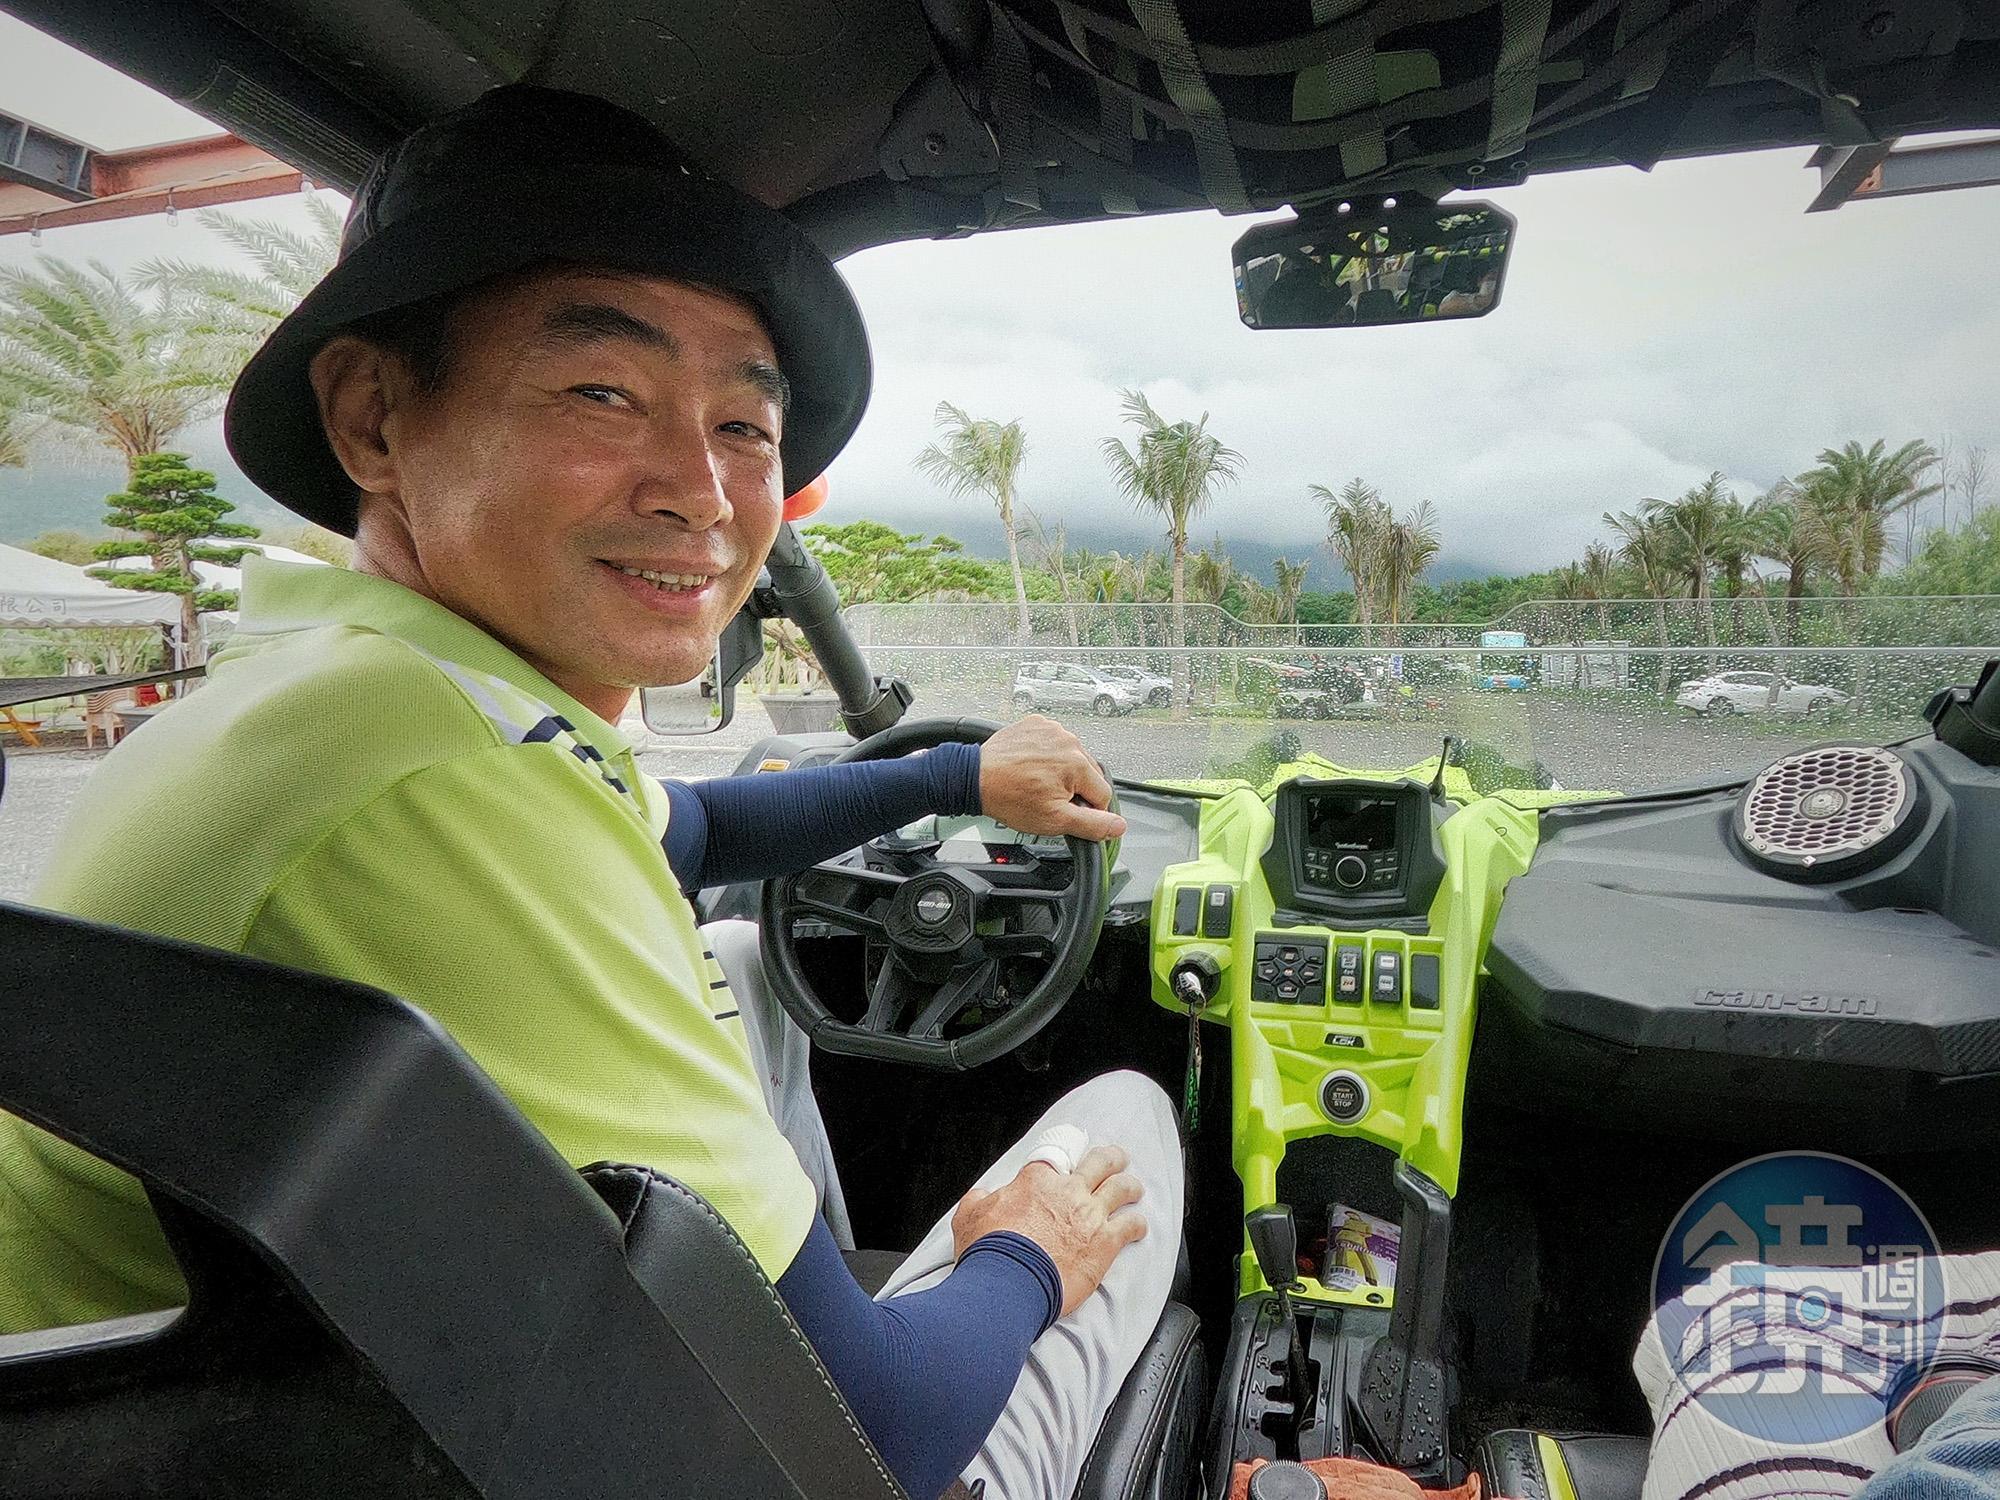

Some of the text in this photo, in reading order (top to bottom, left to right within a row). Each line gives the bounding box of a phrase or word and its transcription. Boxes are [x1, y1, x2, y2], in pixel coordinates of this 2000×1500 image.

[1694, 990, 1877, 1015] can-am
[1332, 1092, 1354, 1100] START
[1251, 1380, 1266, 1395] N
